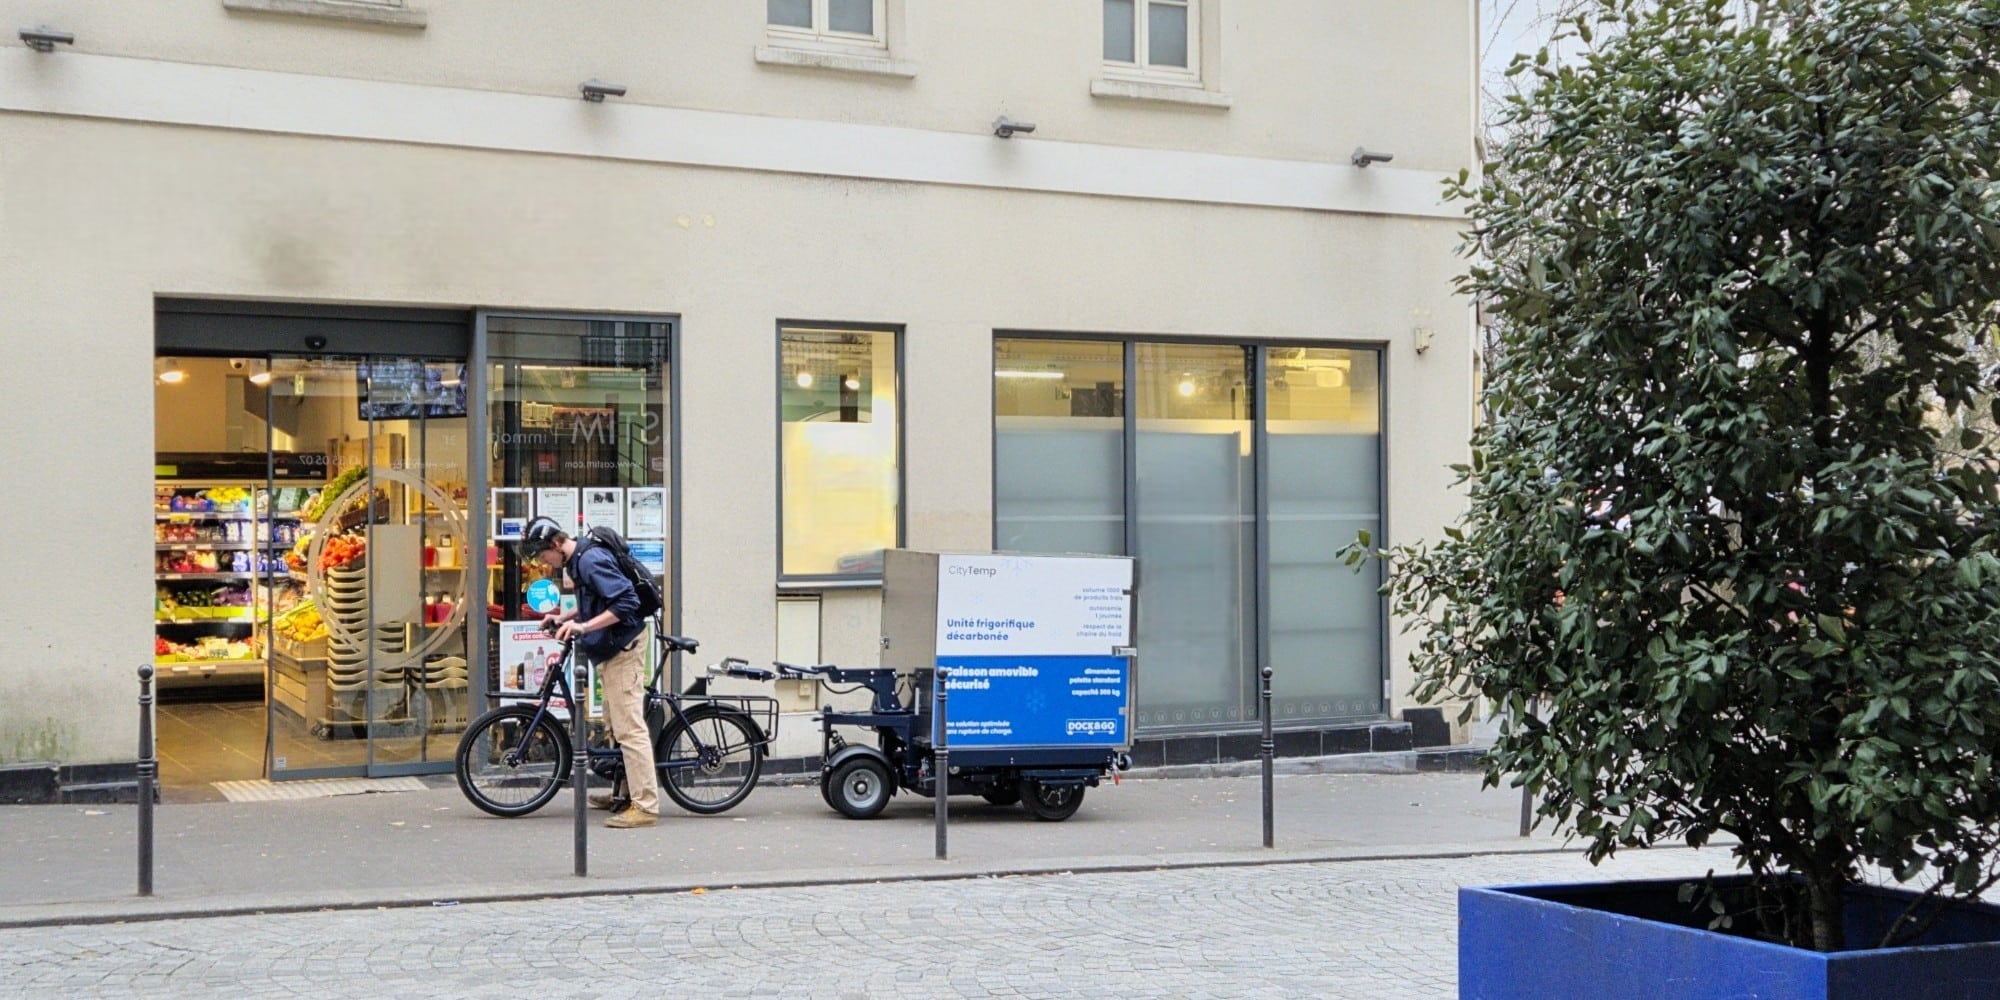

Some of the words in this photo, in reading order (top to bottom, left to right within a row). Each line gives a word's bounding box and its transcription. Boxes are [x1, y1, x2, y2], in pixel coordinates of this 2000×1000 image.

[948, 565, 997, 578] CityTemp
[947, 617, 975, 628] Unité
[976, 618, 1035, 630] frigorifique
[946, 631, 1009, 641] décarbonée
[988, 666, 1039, 677] amovible
[944, 679, 990, 689] sécurisé
[1068, 721, 1115, 730] DOCK&GO
